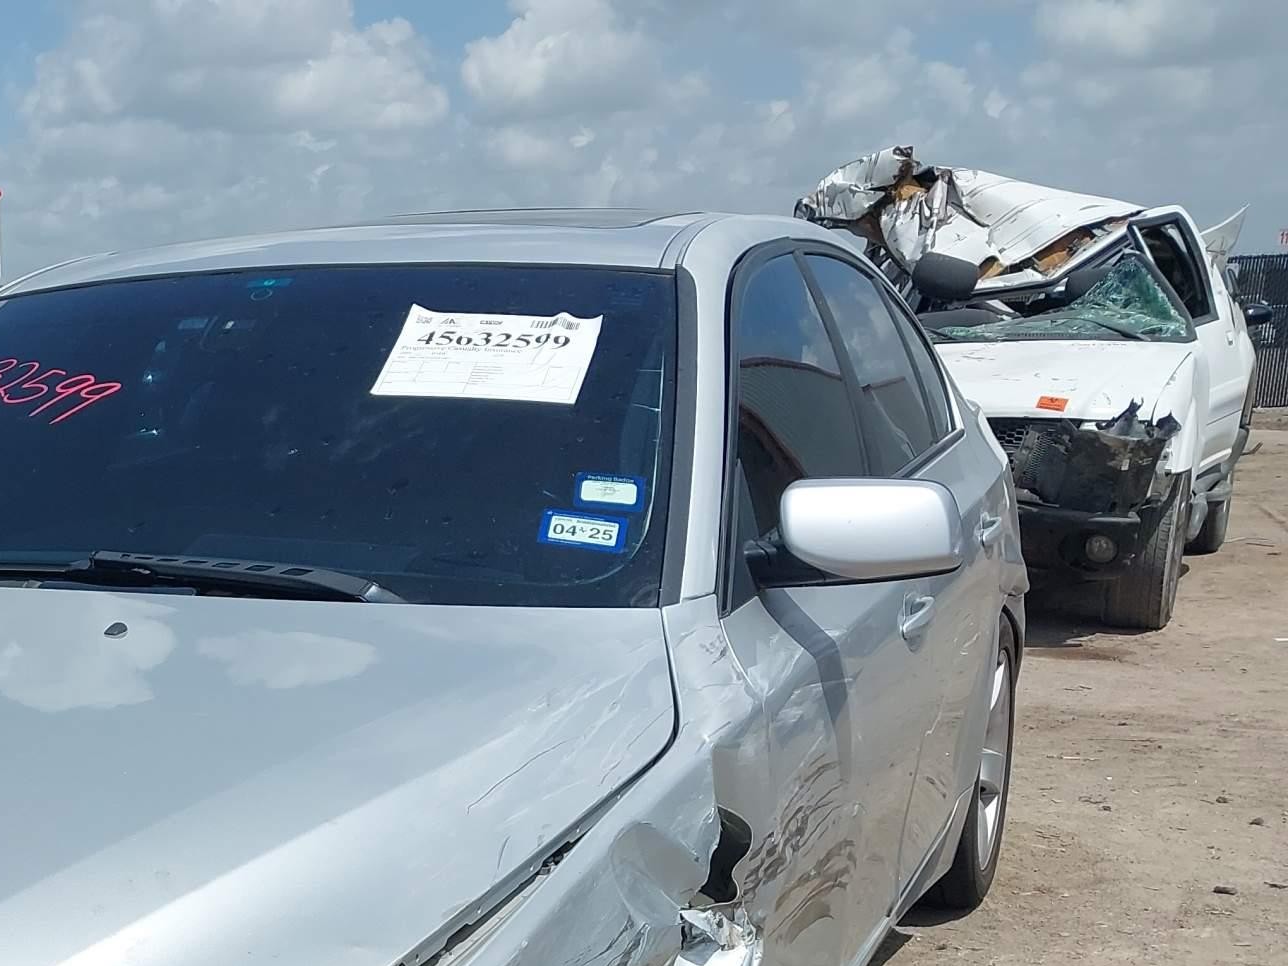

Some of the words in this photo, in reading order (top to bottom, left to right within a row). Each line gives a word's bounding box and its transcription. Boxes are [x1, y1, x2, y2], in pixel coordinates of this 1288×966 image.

[417, 330, 572, 350] 45632599
[552, 523, 577, 537] 04
[588, 527, 614, 541] 25
